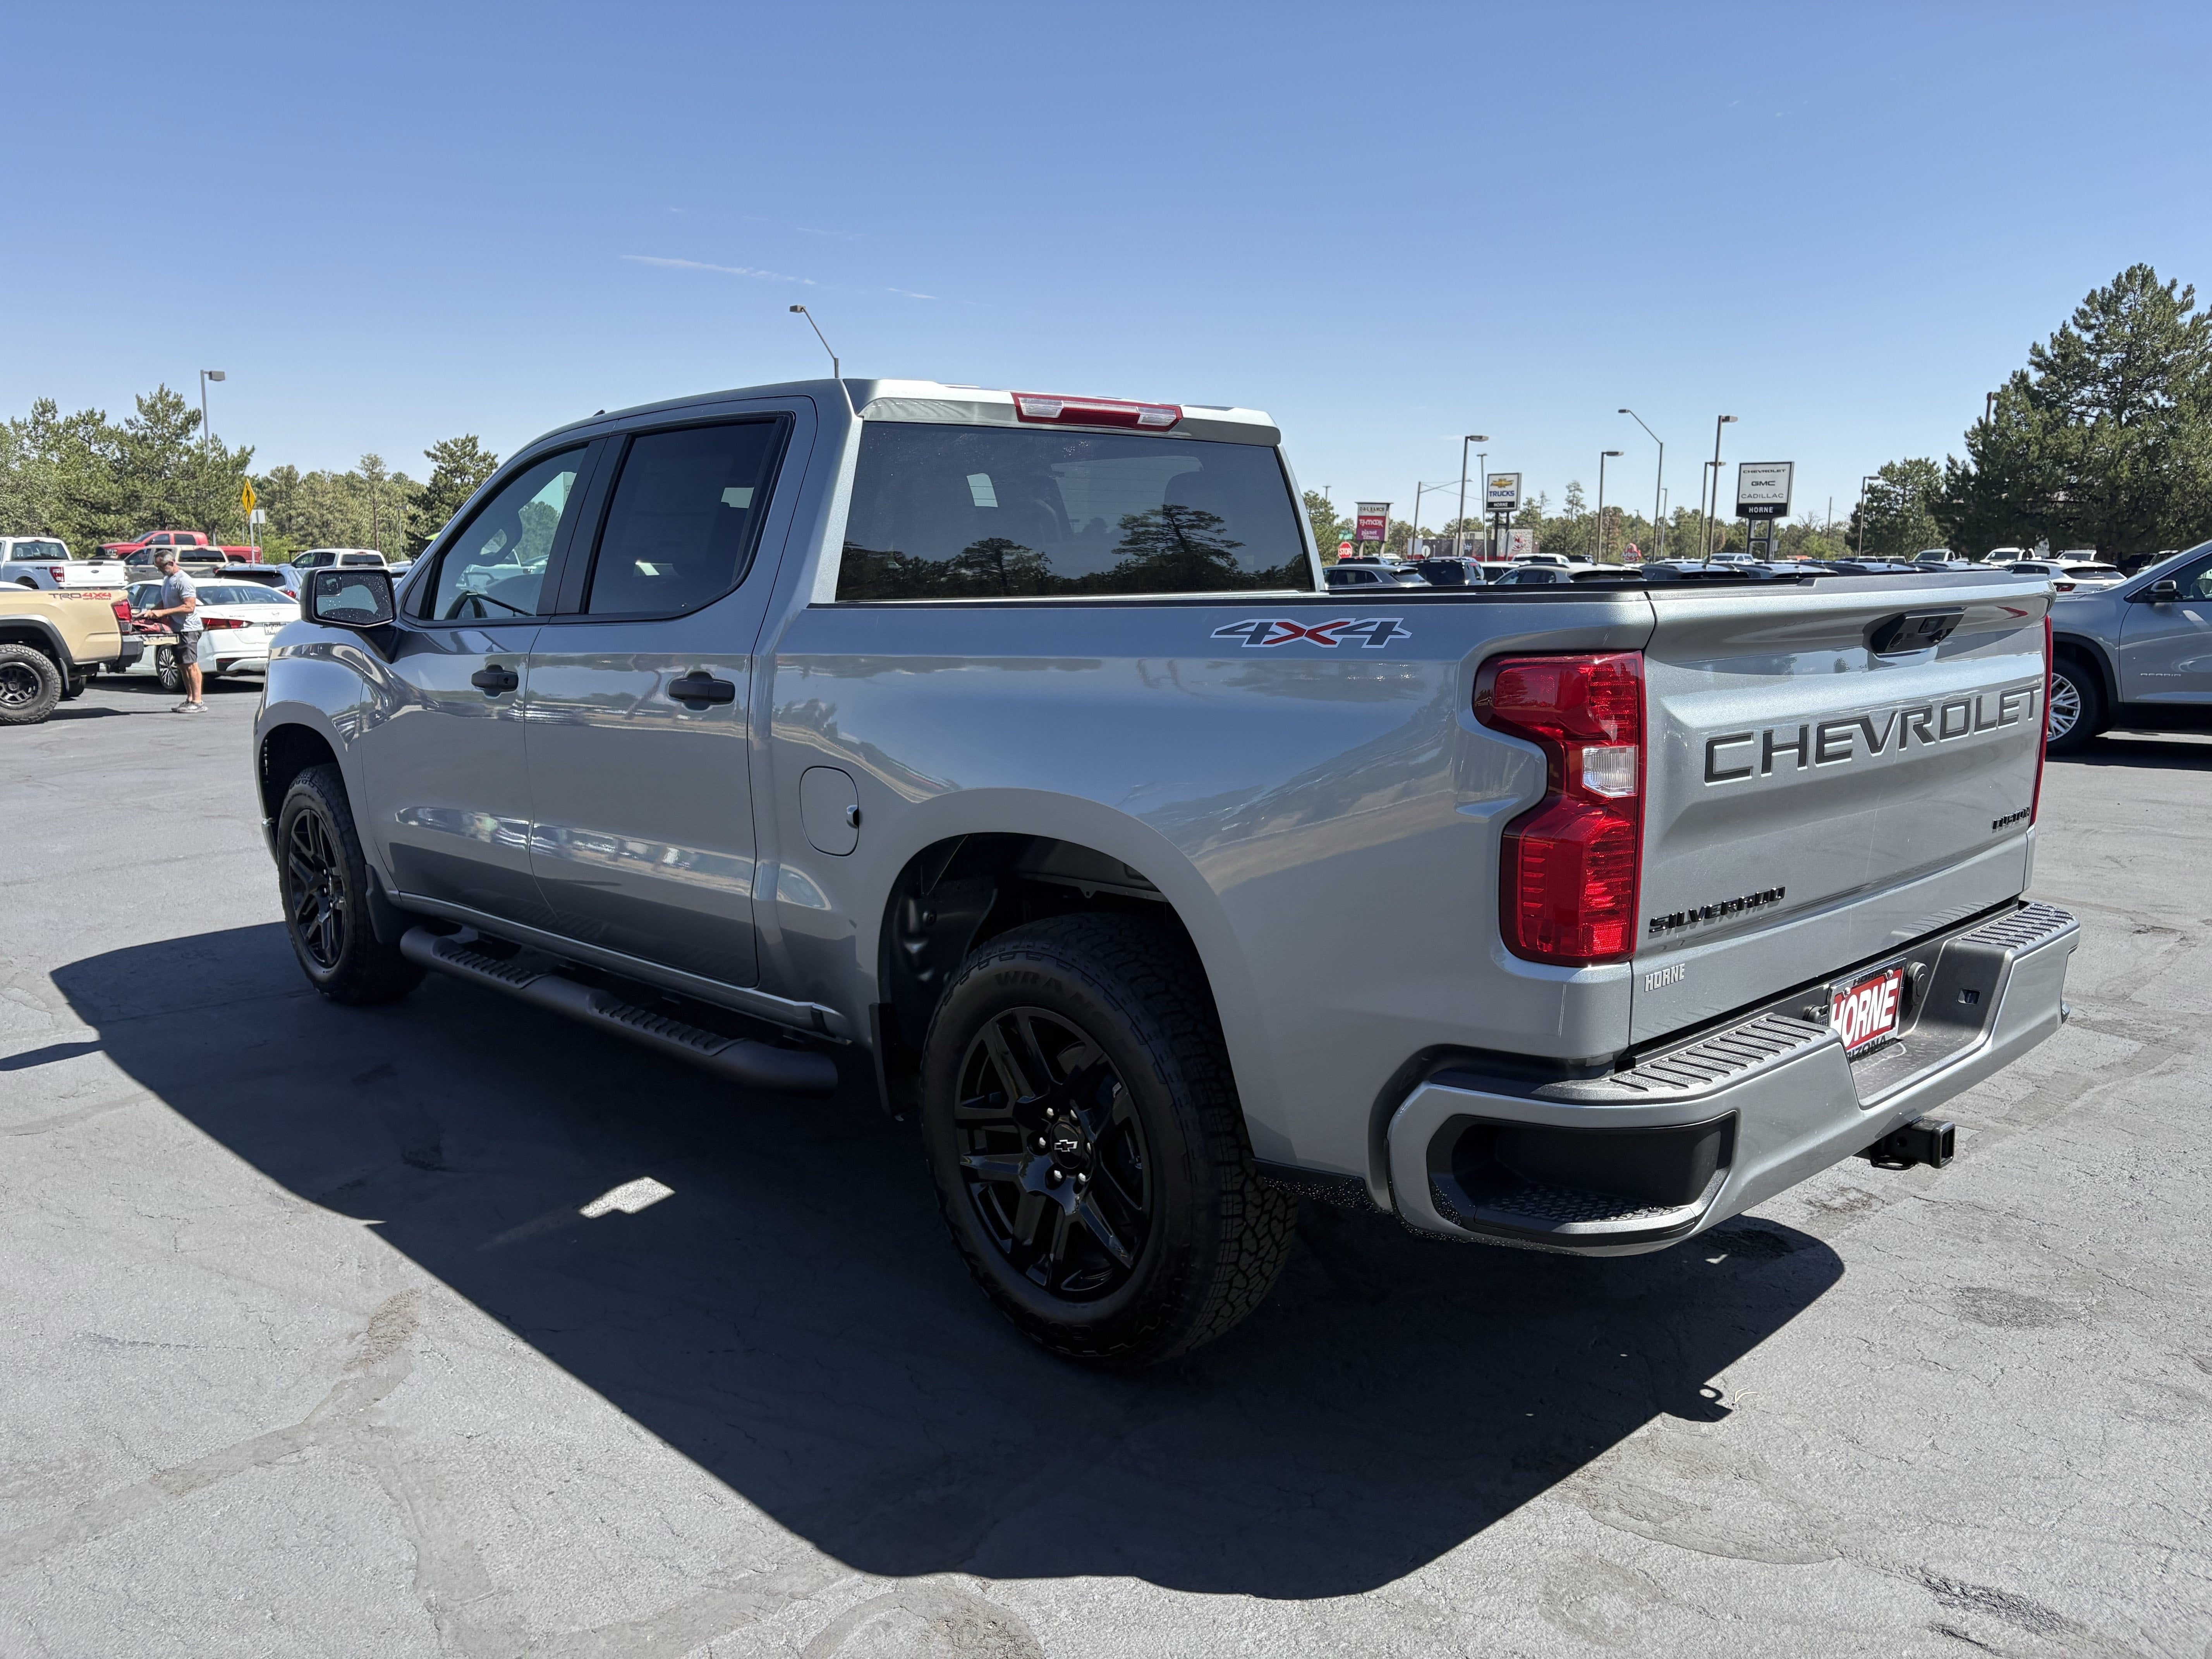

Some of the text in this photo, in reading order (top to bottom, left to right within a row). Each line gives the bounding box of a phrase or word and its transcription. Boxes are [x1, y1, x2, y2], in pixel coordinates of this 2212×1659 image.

[1705, 685, 2042, 786] CHEVROLET
[1649, 886, 1786, 933] SILVERADO
[1644, 963, 1686, 993] HORNE
[1830, 977, 1899, 1048] HORNE
[1846, 1035, 1886, 1061] RIZONA
